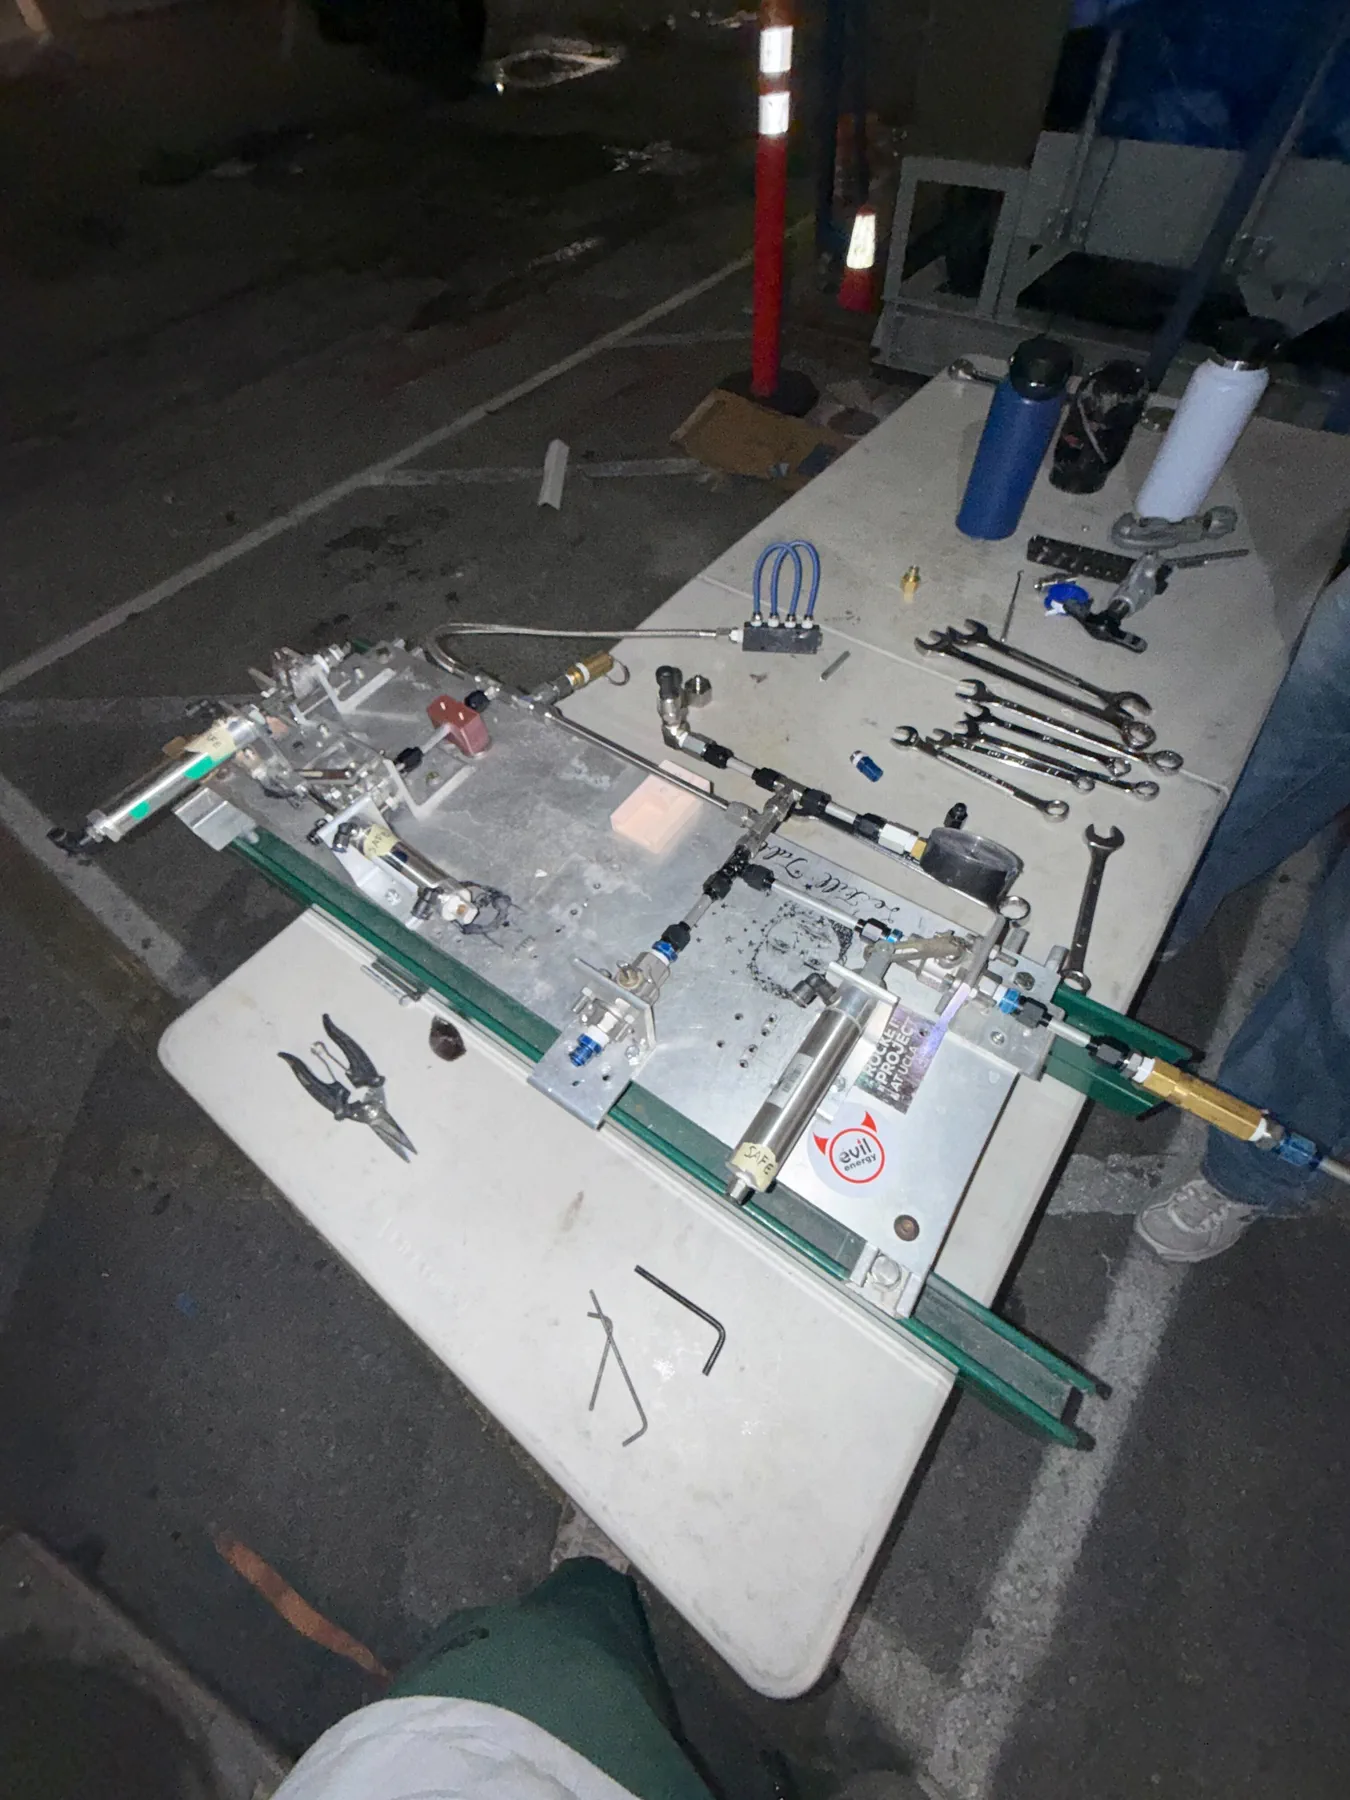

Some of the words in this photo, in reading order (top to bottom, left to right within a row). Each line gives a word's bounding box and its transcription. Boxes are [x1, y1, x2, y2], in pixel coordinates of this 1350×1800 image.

[877, 1015, 914, 1085] PROJECT
[890, 1073, 904, 1092] AT
[897, 1046, 918, 1075] UCLA
[743, 1145, 774, 1175] SAFE
[839, 1137, 872, 1163] evil
[844, 1152, 877, 1171] energy
